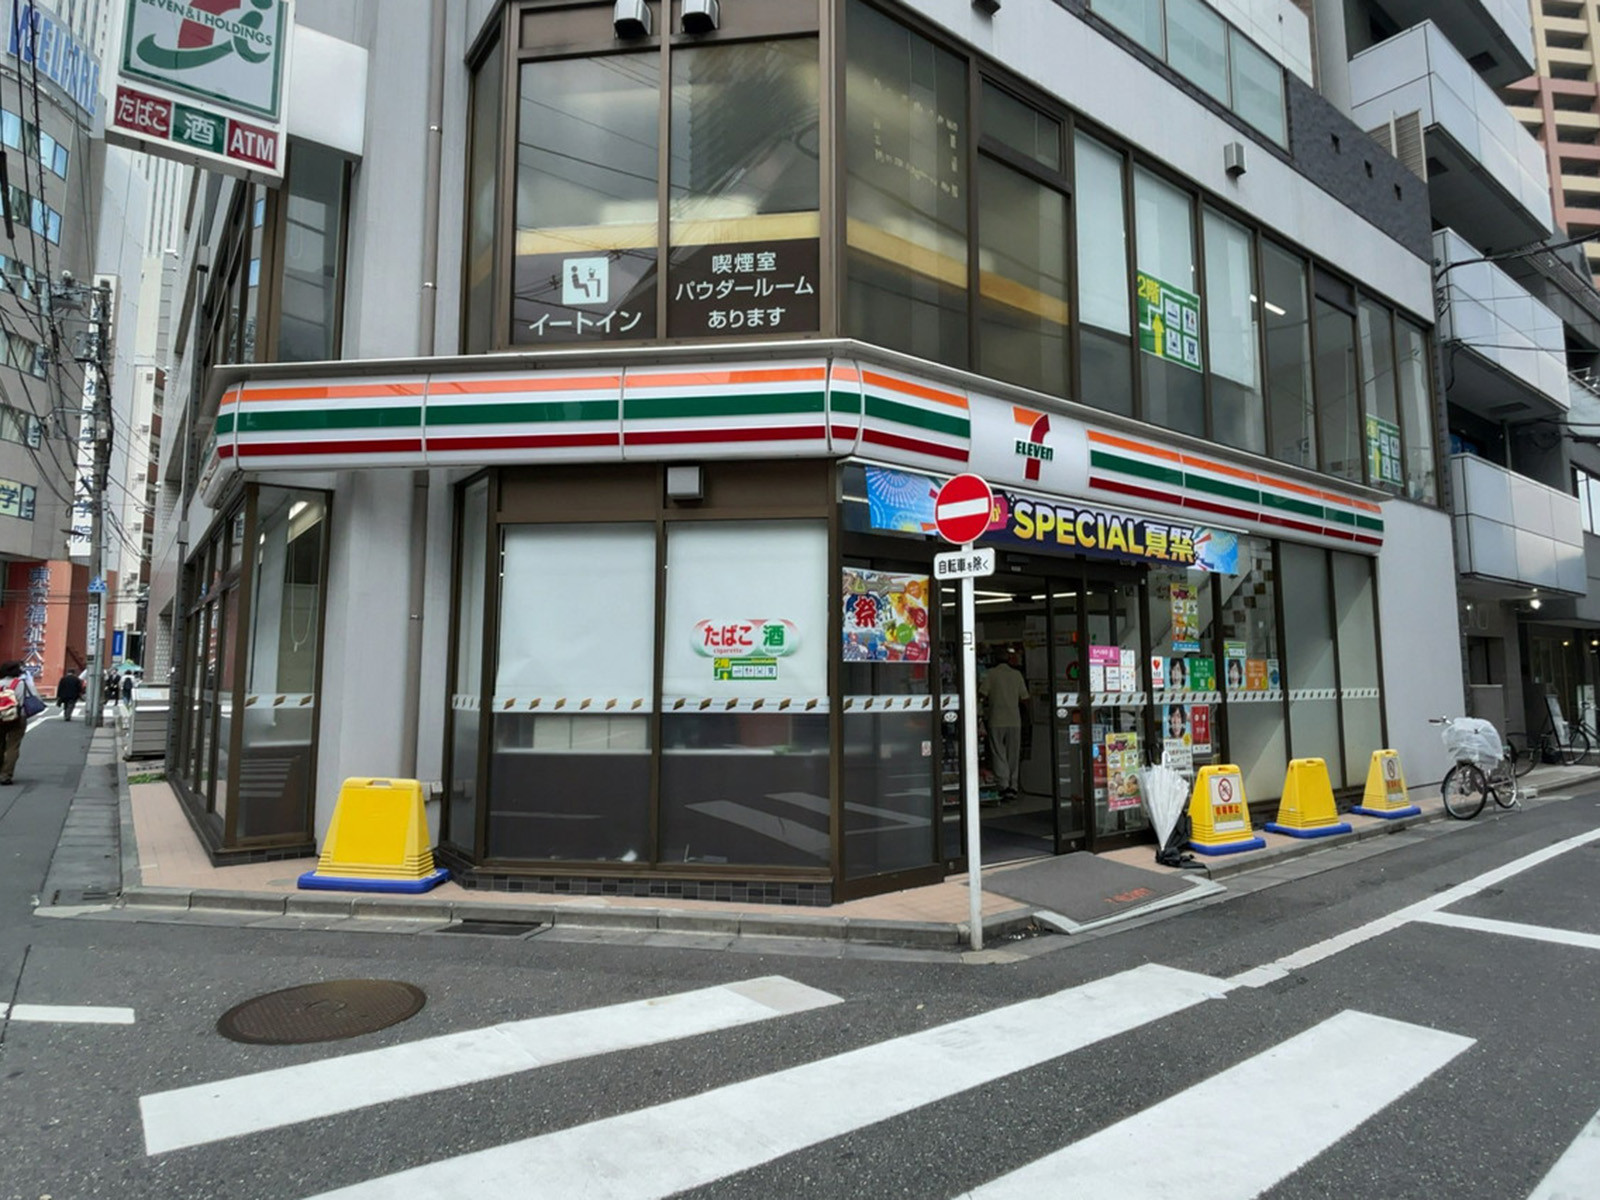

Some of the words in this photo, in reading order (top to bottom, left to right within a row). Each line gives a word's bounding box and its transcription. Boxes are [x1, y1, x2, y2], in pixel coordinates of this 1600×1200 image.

[205, 14, 273, 46] HOLDINGS
[117, 94, 168, 131] たばこ
[183, 112, 216, 146] 酒
[230, 128, 275, 163] ATM
[711, 251, 777, 275] 喫煙室
[675, 276, 815, 301] パウダールーム
[528, 310, 643, 336] イートイン
[707, 307, 786, 330] あります
[938, 555, 989, 575] 自転車を除く
[854, 595, 877, 628] 祭
[704, 624, 753, 647] たばこ
[763, 624, 785, 647] 酒
